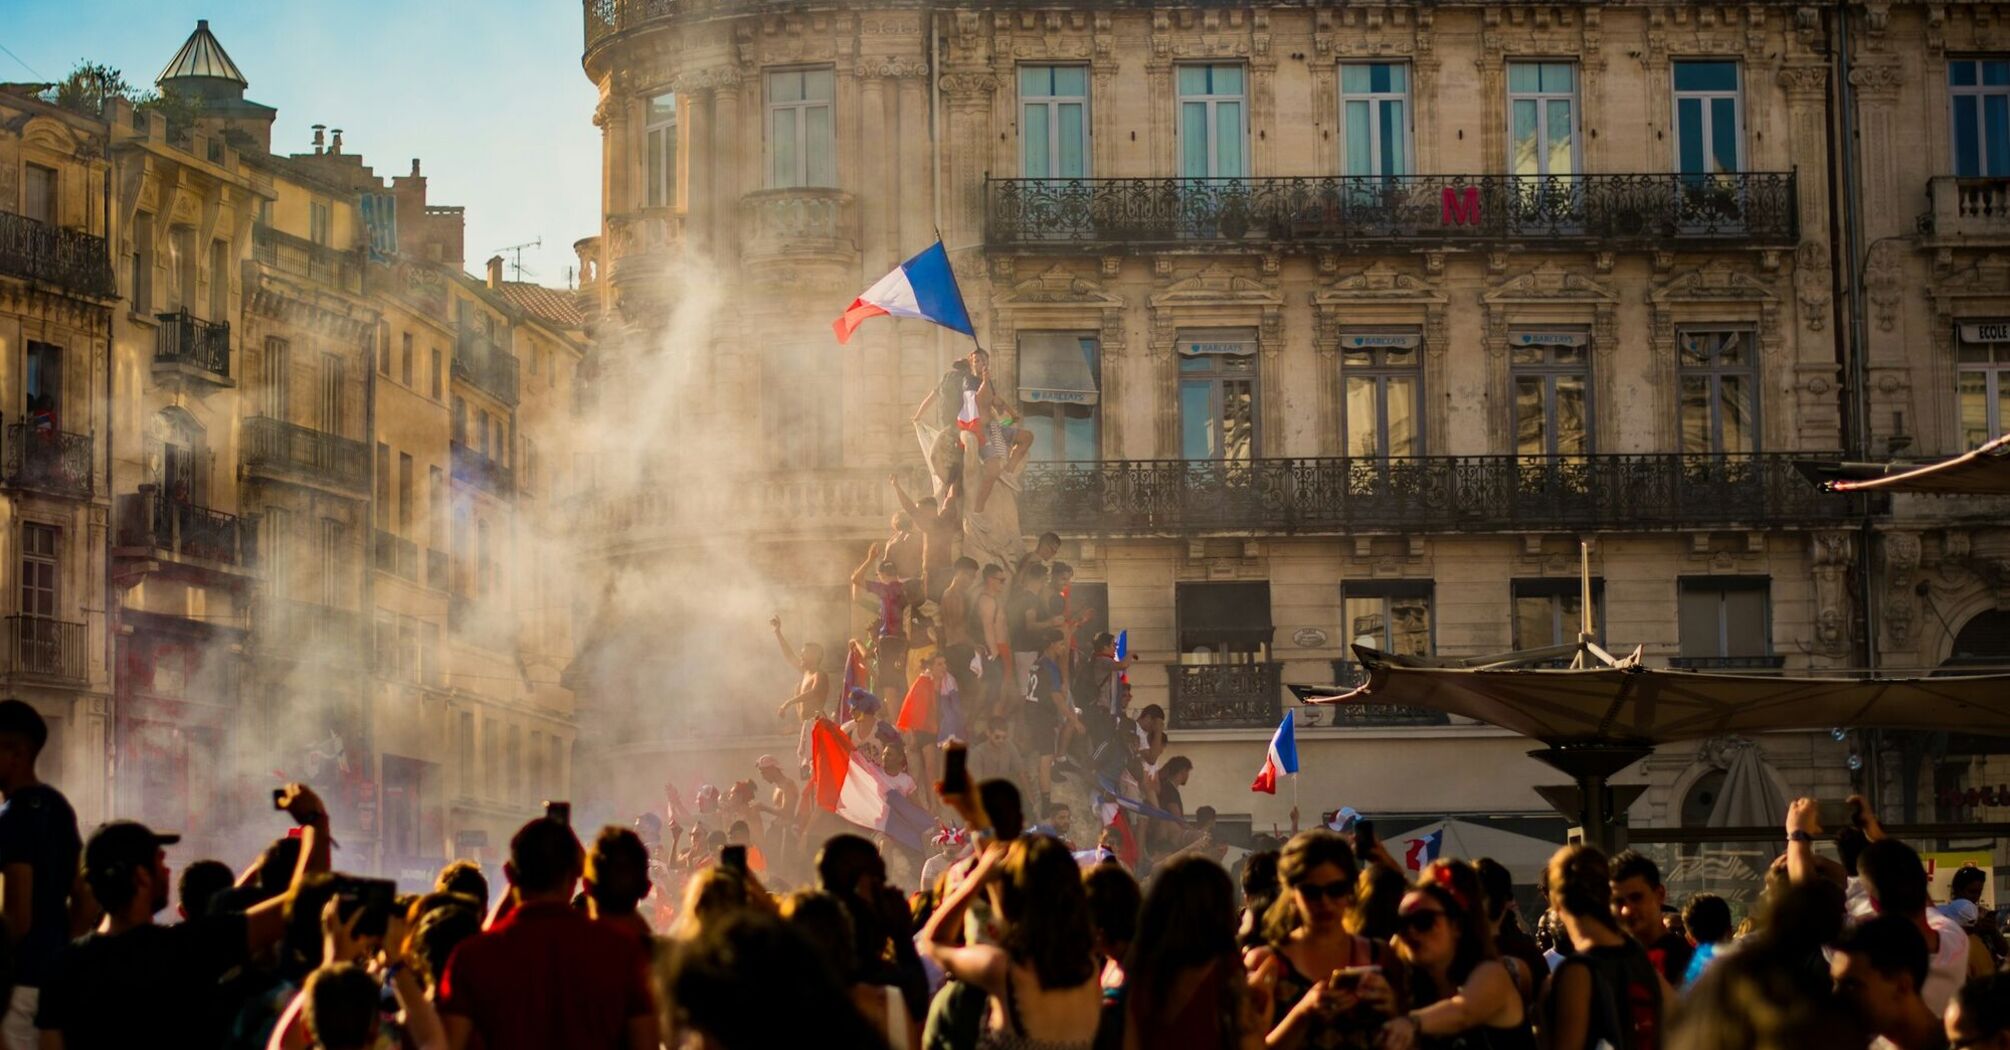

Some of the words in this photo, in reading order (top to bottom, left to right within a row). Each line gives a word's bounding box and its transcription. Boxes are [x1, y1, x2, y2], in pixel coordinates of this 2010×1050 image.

[1442, 185, 1481, 225] M
[1979, 325, 2008, 339] ECOLE
[1364, 337, 1407, 345] BARCLAYS
[1532, 335, 1574, 344] BARCLAYS
[1202, 343, 1242, 352] BARCLAYS
[1042, 391, 1083, 401] BARCLAYS
